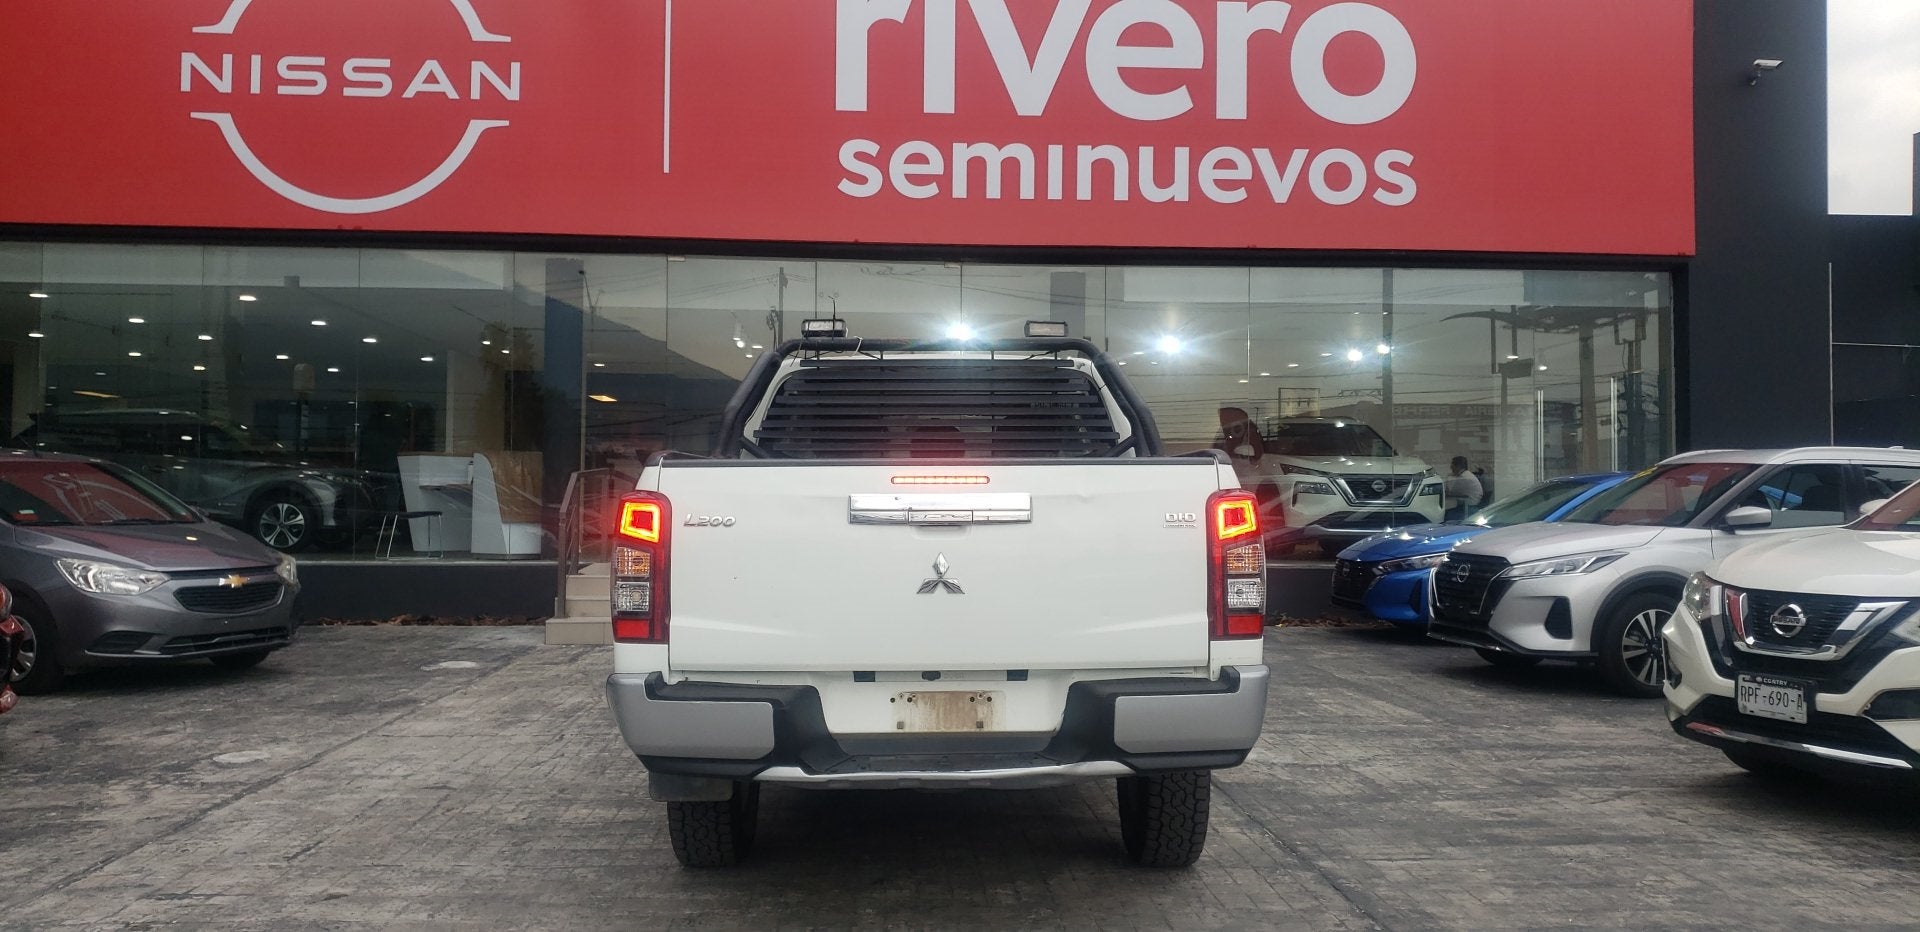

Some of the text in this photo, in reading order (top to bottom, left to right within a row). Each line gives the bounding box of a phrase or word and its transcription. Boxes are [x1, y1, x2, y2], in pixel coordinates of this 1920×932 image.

[180, 52, 521, 101] NISSAN
[835, 0, 1417, 125] rivero
[837, 138, 1418, 206] seminuevos
[683, 512, 737, 527] L200
[1740, 686, 1803, 710] RPF-690-A
